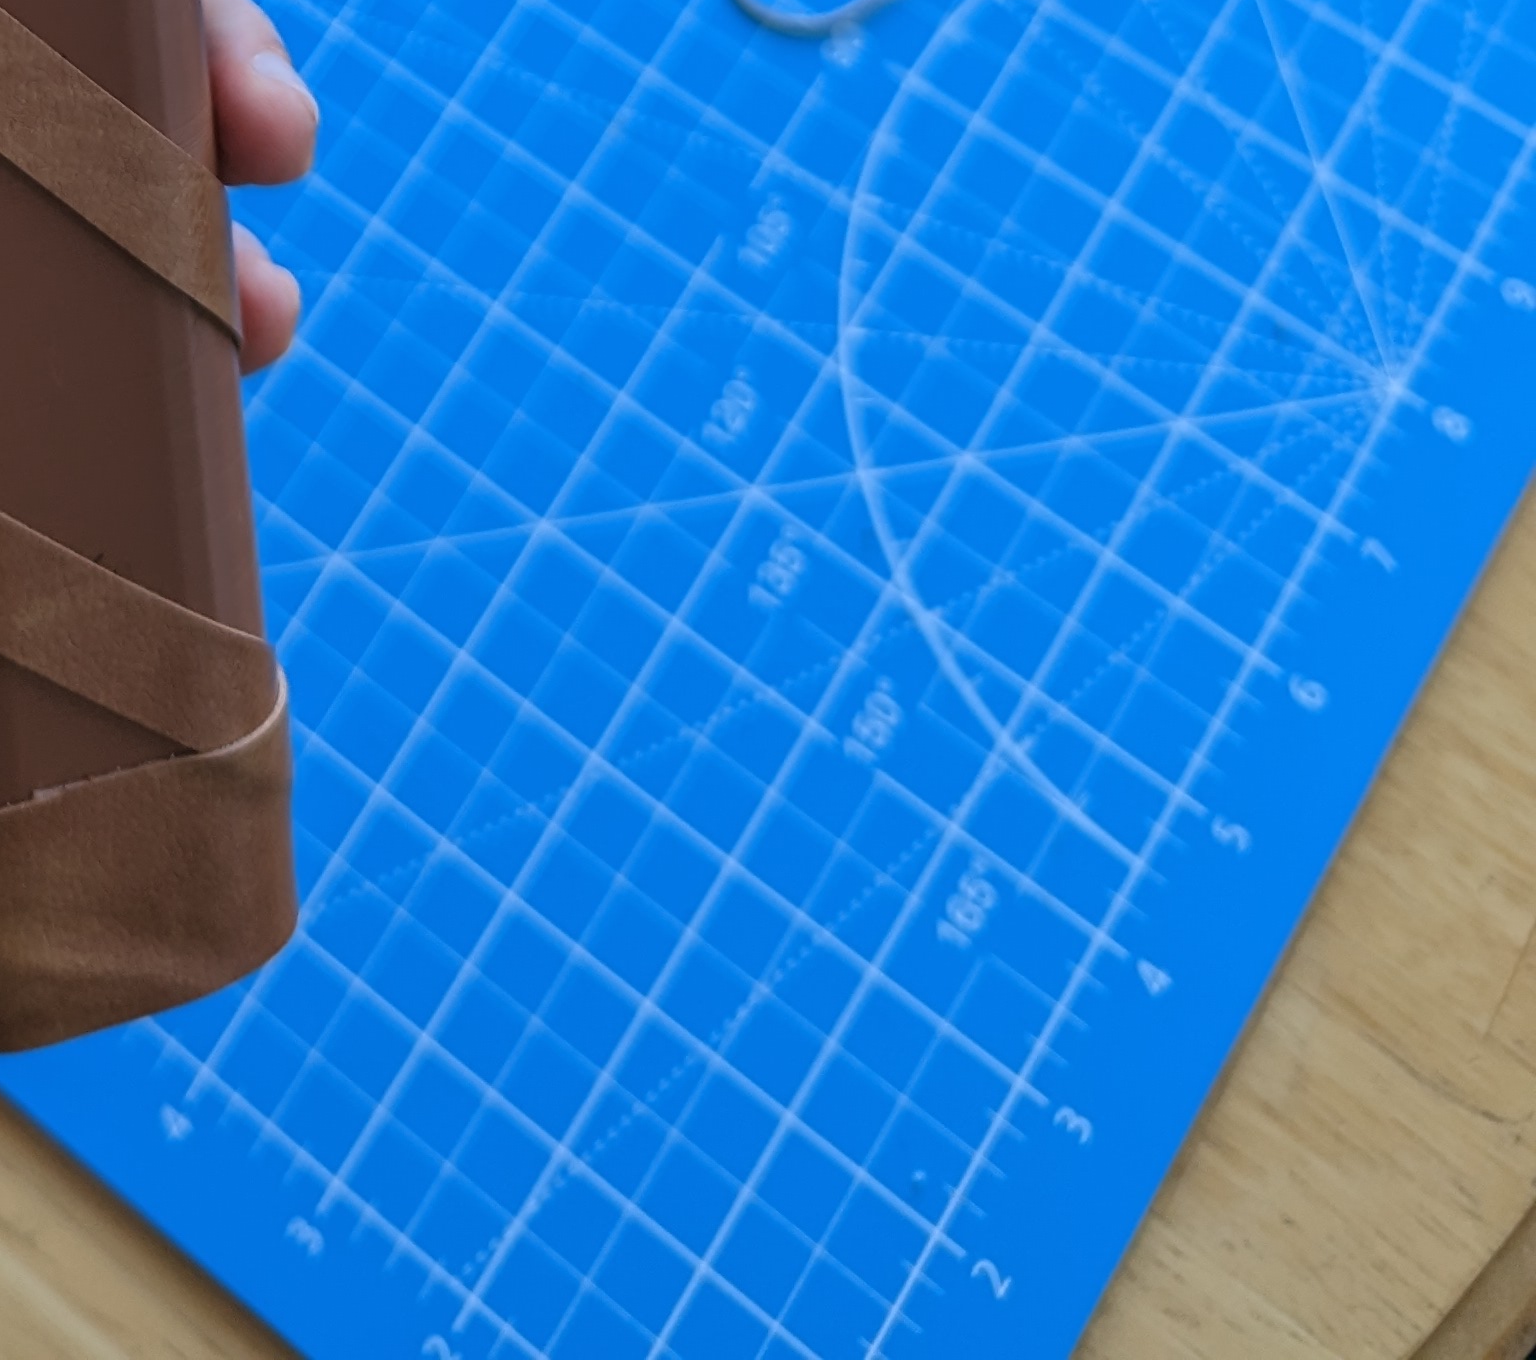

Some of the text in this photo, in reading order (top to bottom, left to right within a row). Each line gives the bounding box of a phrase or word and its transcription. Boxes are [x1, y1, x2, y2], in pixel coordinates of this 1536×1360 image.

[1362, 537, 1400, 573] 7
[1289, 673, 1331, 713] 6
[843, 675, 903, 762] 150°
[1210, 815, 1253, 854] 5
[1135, 958, 1173, 997] 4
[159, 1103, 194, 1142] 4
[1053, 1106, 1094, 1146] 3
[285, 1215, 325, 1259] 3
[970, 1258, 1013, 1301] 2
